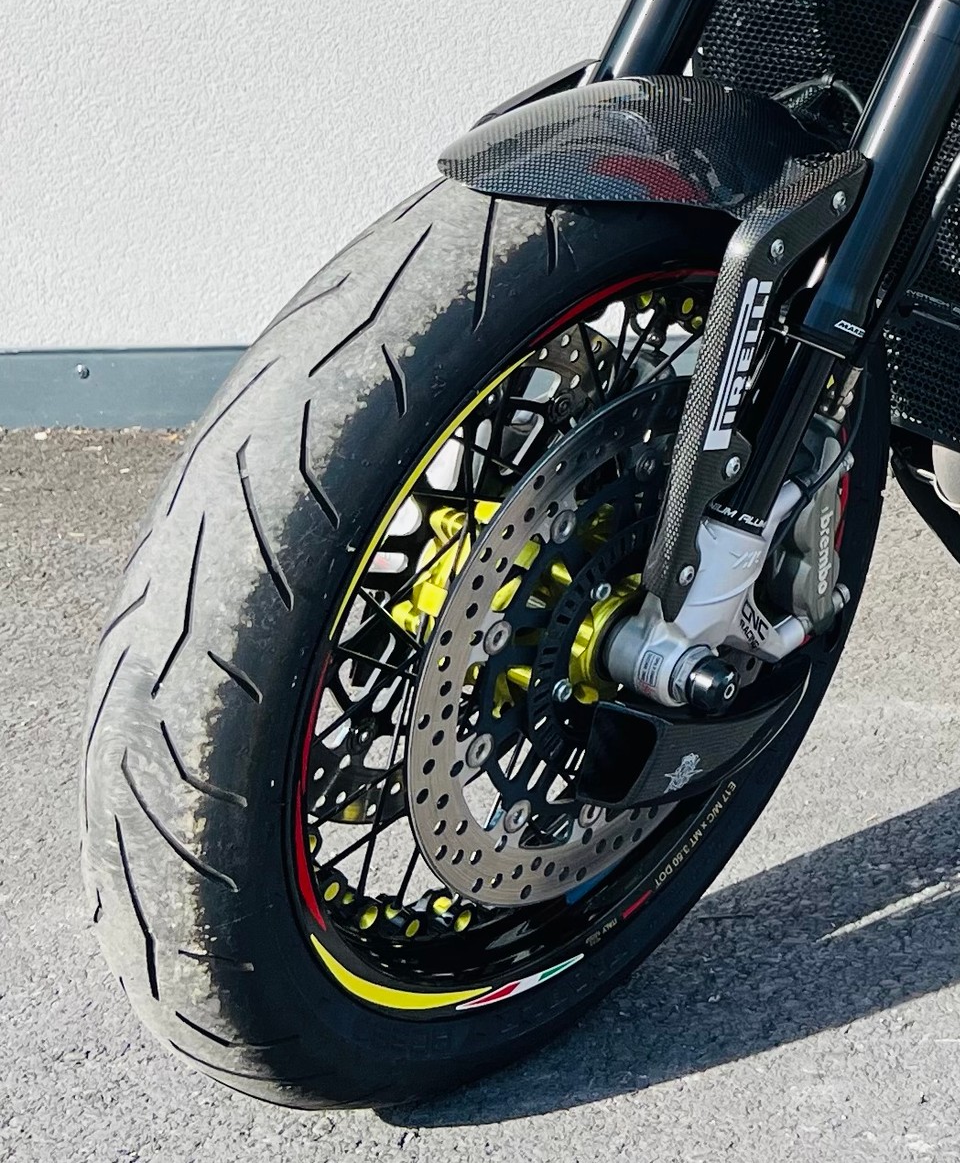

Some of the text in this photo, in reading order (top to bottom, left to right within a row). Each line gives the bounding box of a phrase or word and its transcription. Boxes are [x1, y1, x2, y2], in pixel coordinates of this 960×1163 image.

[703, 277, 773, 451] PIRELLI
[817, 509, 834, 595] brembo
[654, 863, 673, 889] DOT
